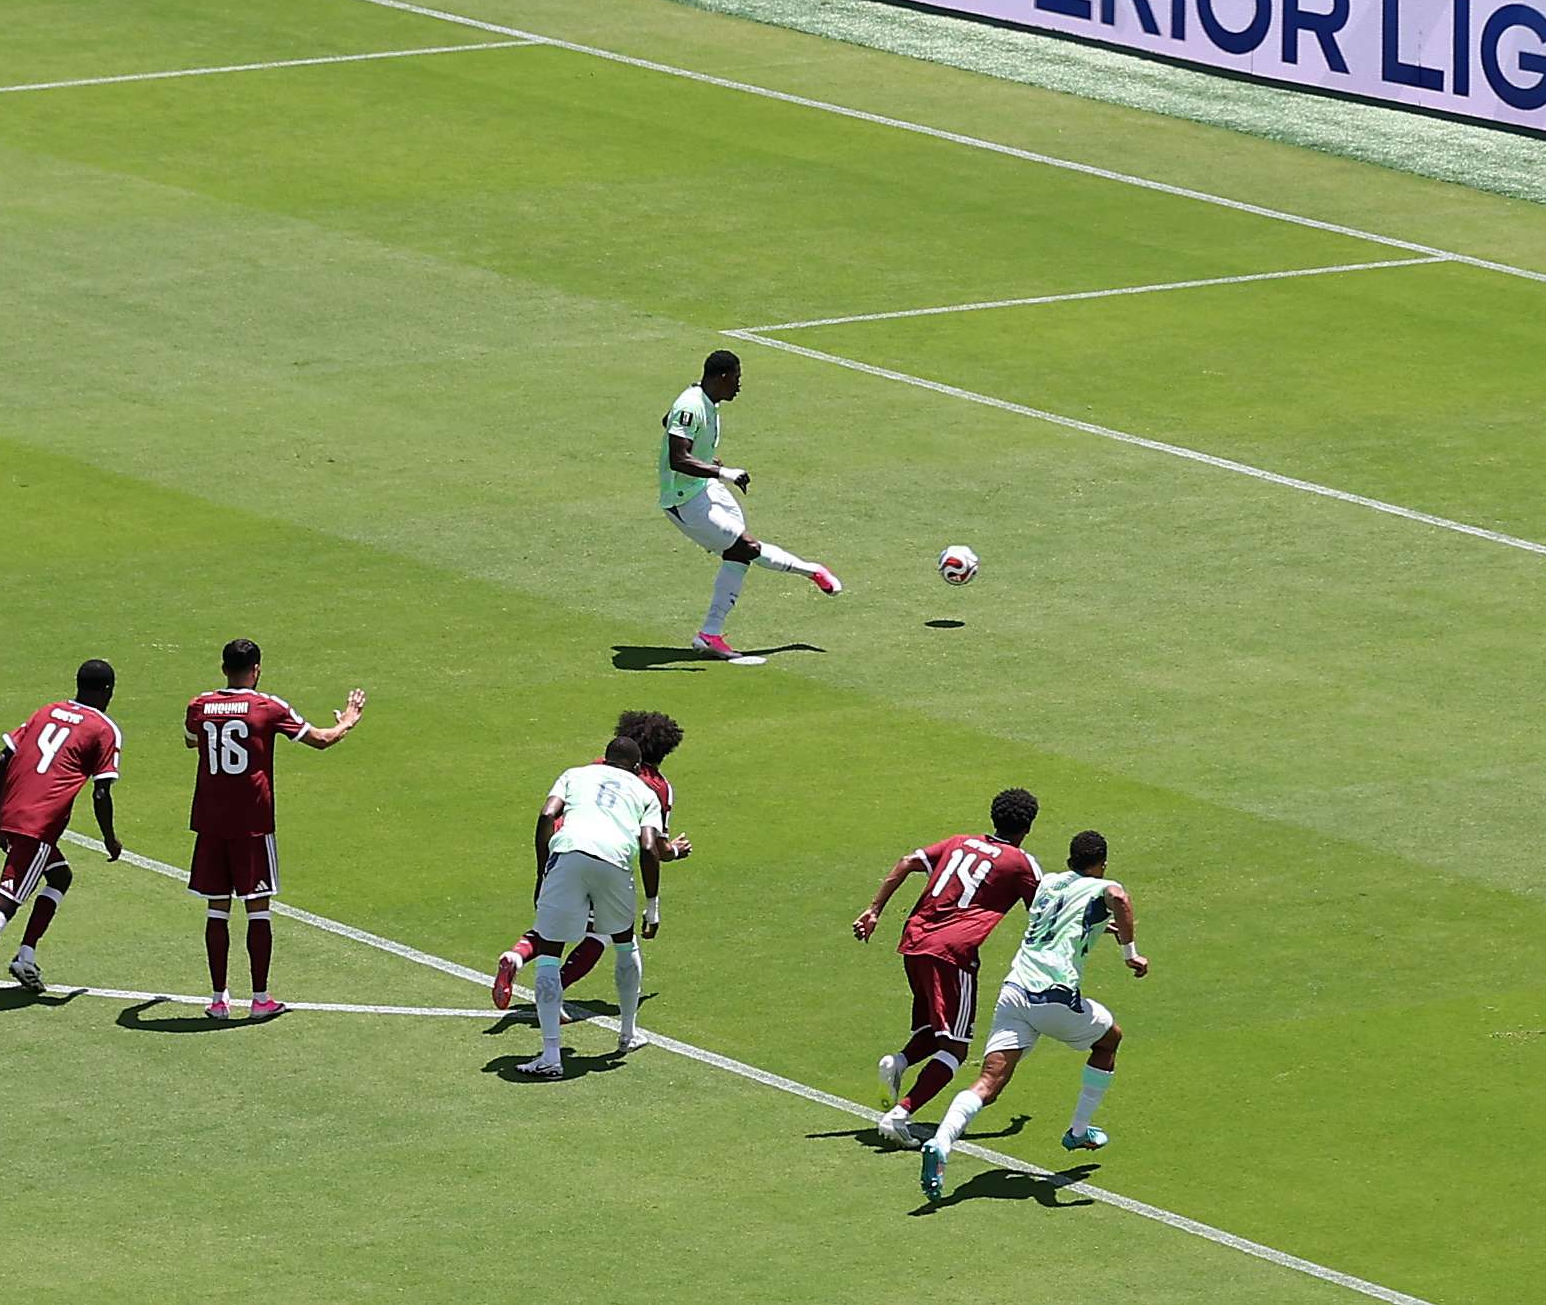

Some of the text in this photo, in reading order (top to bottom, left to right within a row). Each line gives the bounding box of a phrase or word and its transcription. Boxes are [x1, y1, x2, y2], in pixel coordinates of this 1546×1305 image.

[36, 722, 71, 774] 4
[202, 719, 249, 775] 16
[596, 780, 621, 809] 6
[931, 848, 993, 909] 14
